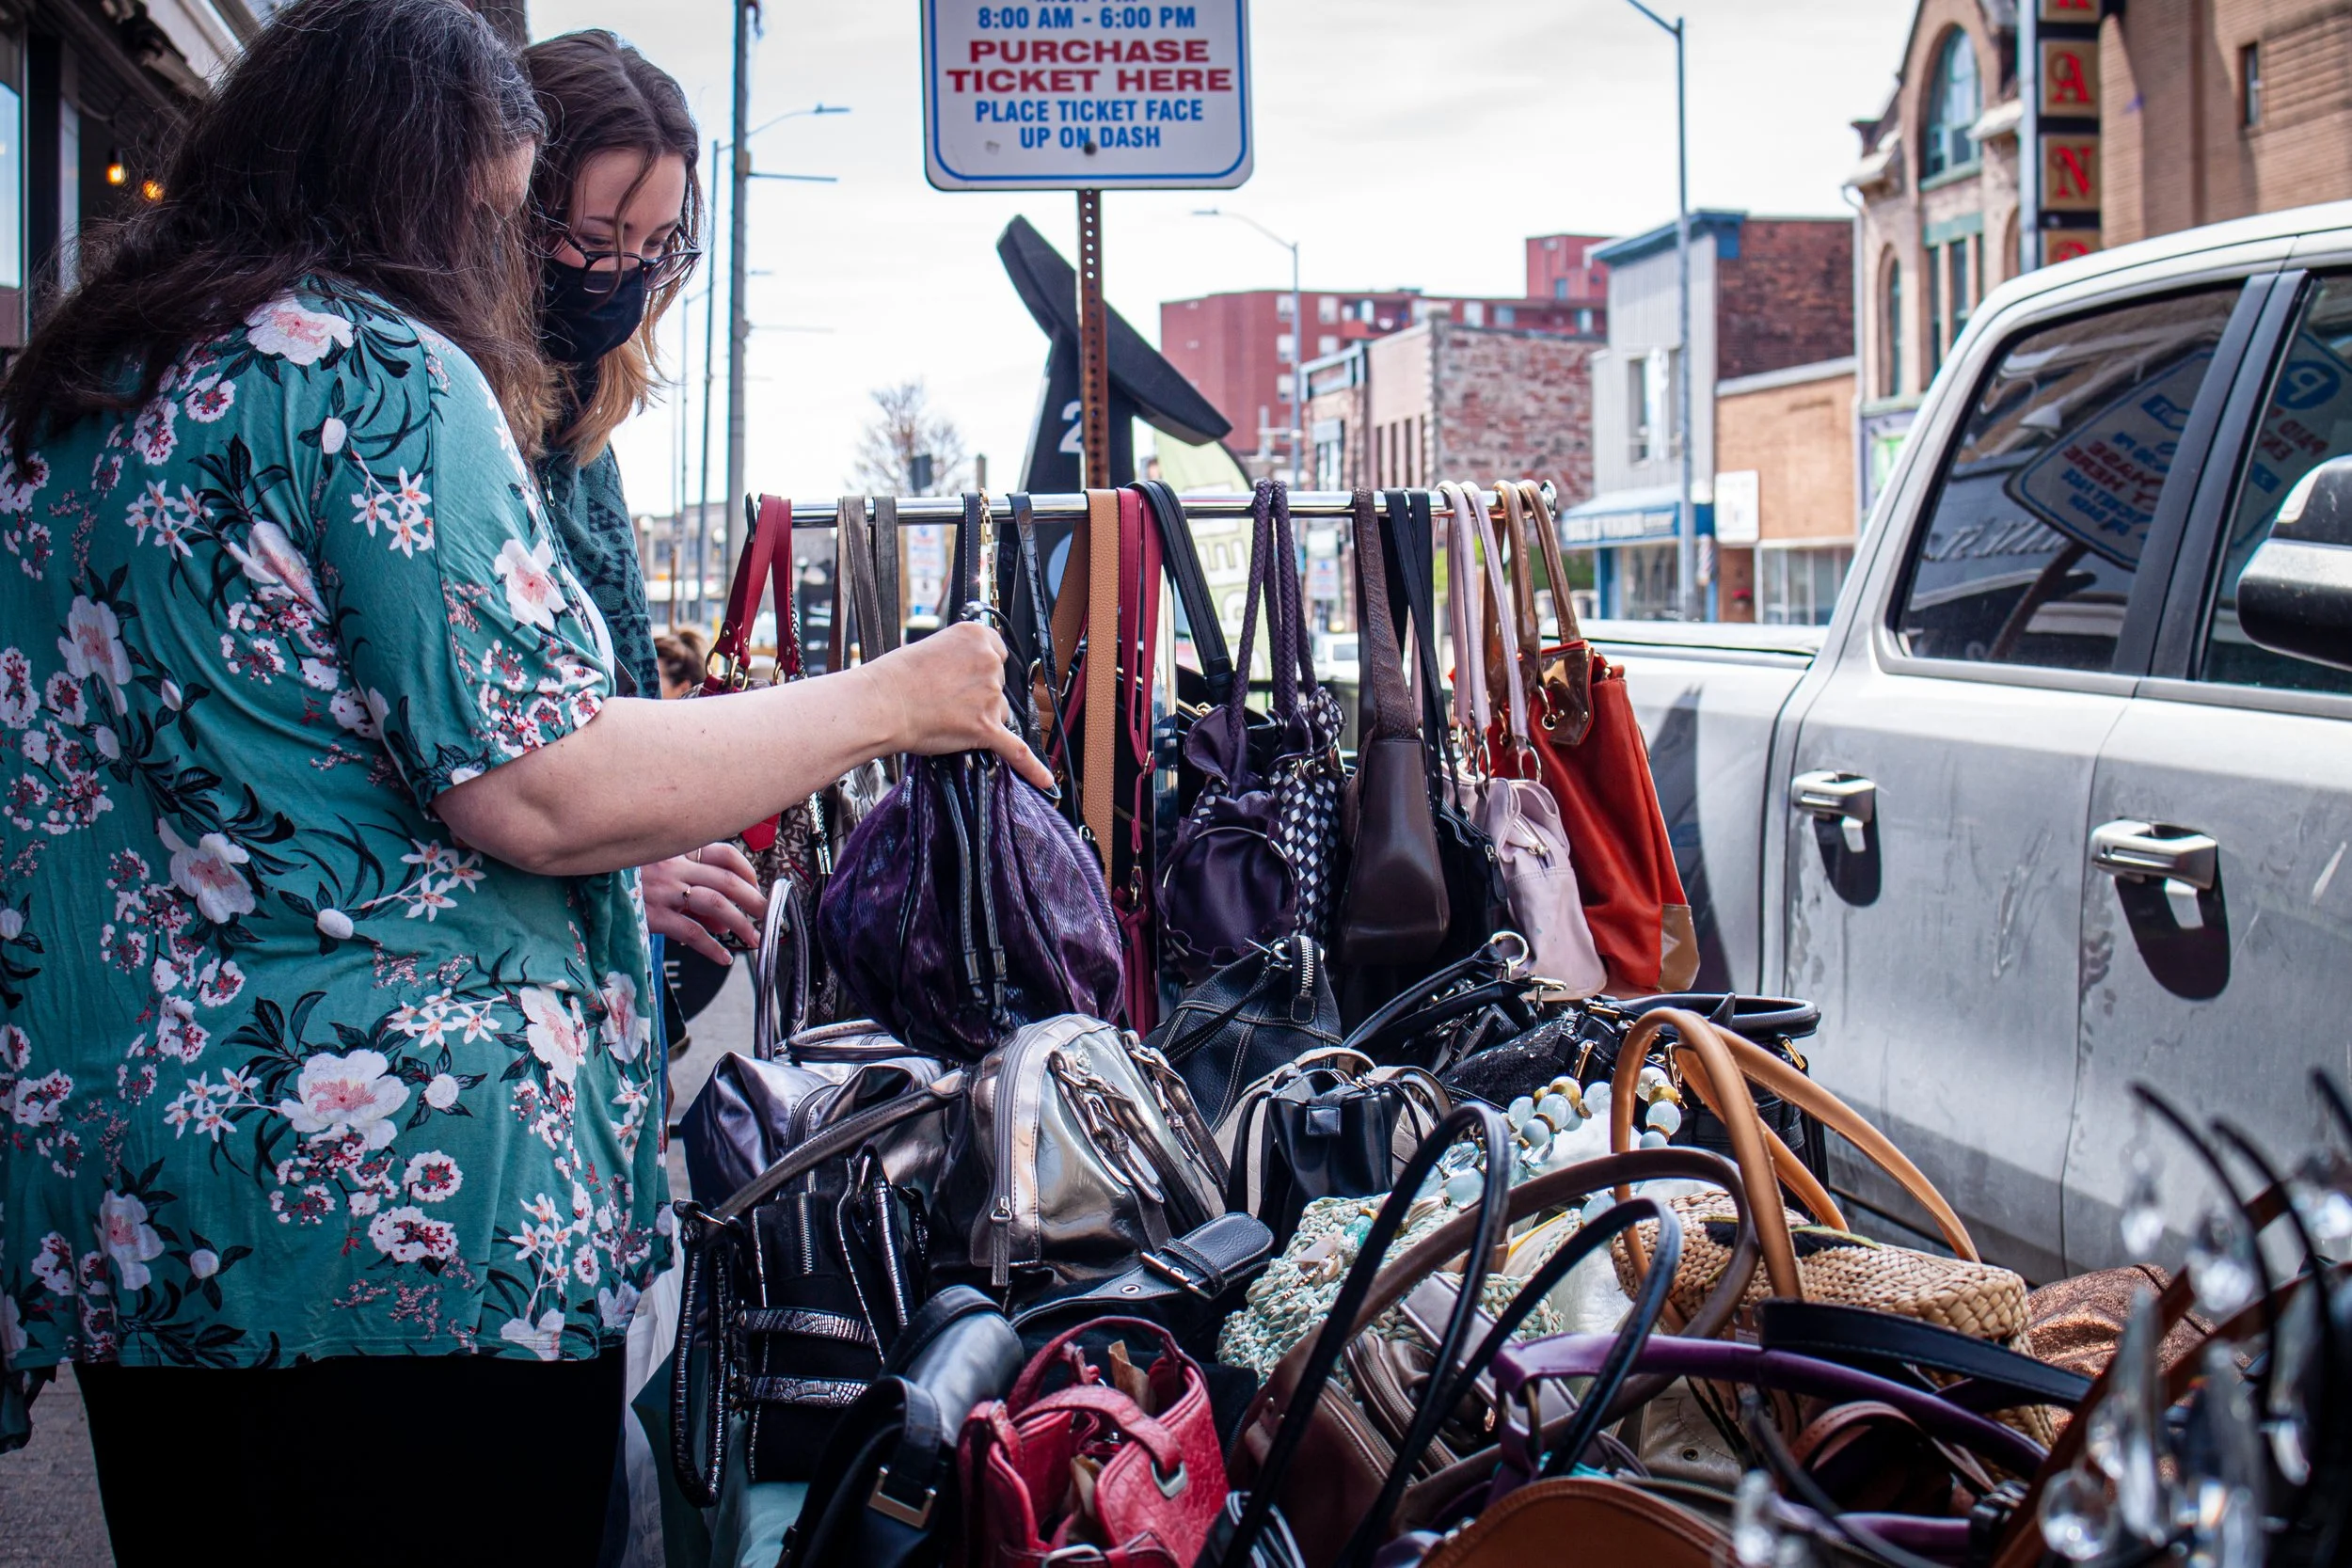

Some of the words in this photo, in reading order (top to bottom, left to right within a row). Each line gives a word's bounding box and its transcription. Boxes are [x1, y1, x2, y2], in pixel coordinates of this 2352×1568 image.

[977, 6, 1030, 30] 8:00
[1037, 6, 1074, 30] AM
[1081, 16, 1092, 24] -
[1098, 6, 1152, 30] 6:00
[1158, 6, 1197, 30] PM
[969, 40, 1210, 64] PURCHASE
[946, 69, 1100, 93] TICKET
[1117, 69, 1232, 93] HERE
[974, 98, 1050, 124] PLACE
[1056, 98, 1138, 123] TICKET
[1144, 97, 1204, 122] FACE
[1018, 126, 1053, 150] UP
[1057, 125, 1092, 150] ON
[1098, 124, 1163, 150] DASH
